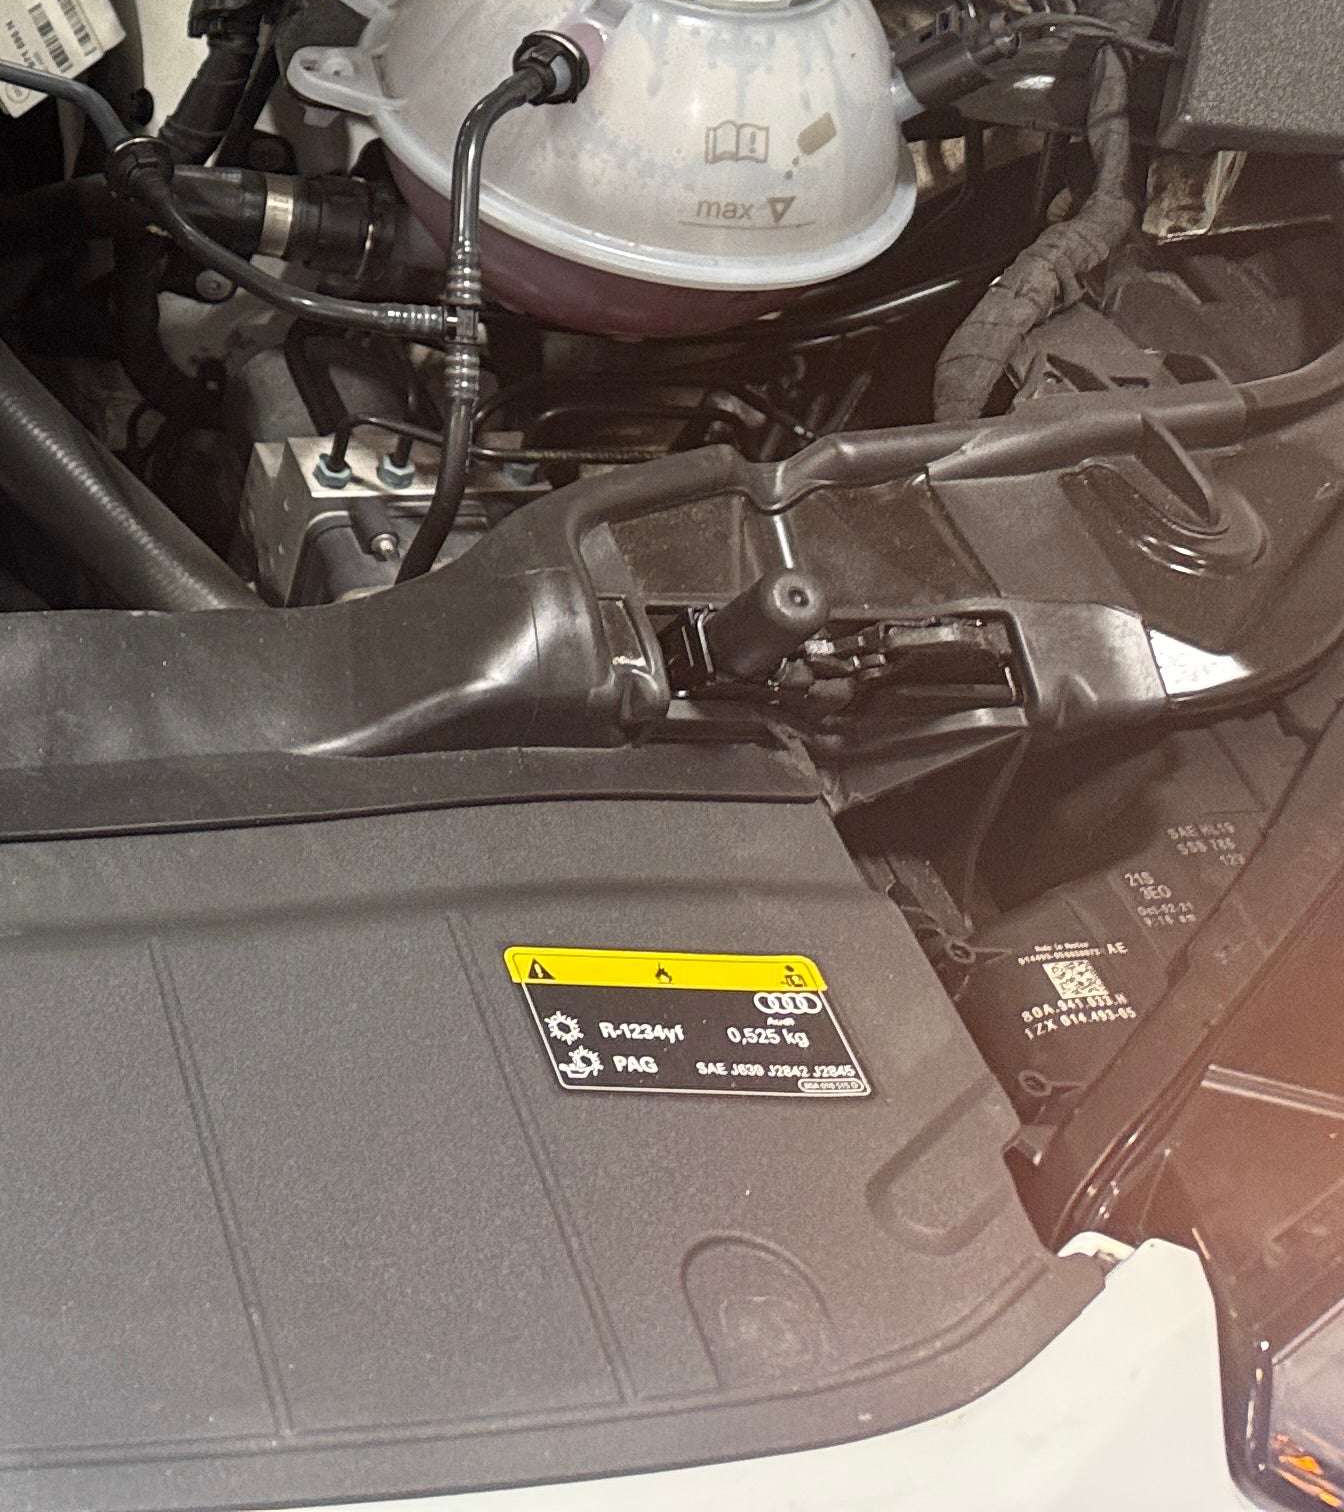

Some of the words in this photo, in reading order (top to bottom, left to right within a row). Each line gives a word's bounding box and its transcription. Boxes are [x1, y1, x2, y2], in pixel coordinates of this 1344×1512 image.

[696, 200, 754, 219] max
[1107, 942, 1128, 954] AE
[599, 1022, 685, 1043] R-1234yf
[726, 1027, 781, 1046] 0,525
[781, 1028, 810, 1048] kg
[1025, 1018, 1058, 1040] 1ZX
[613, 1055, 659, 1073] PAG
[696, 1061, 728, 1076] SAE
[730, 1063, 765, 1077] J639
[768, 1064, 810, 1077] J2842
[813, 1064, 856, 1077] J2845
